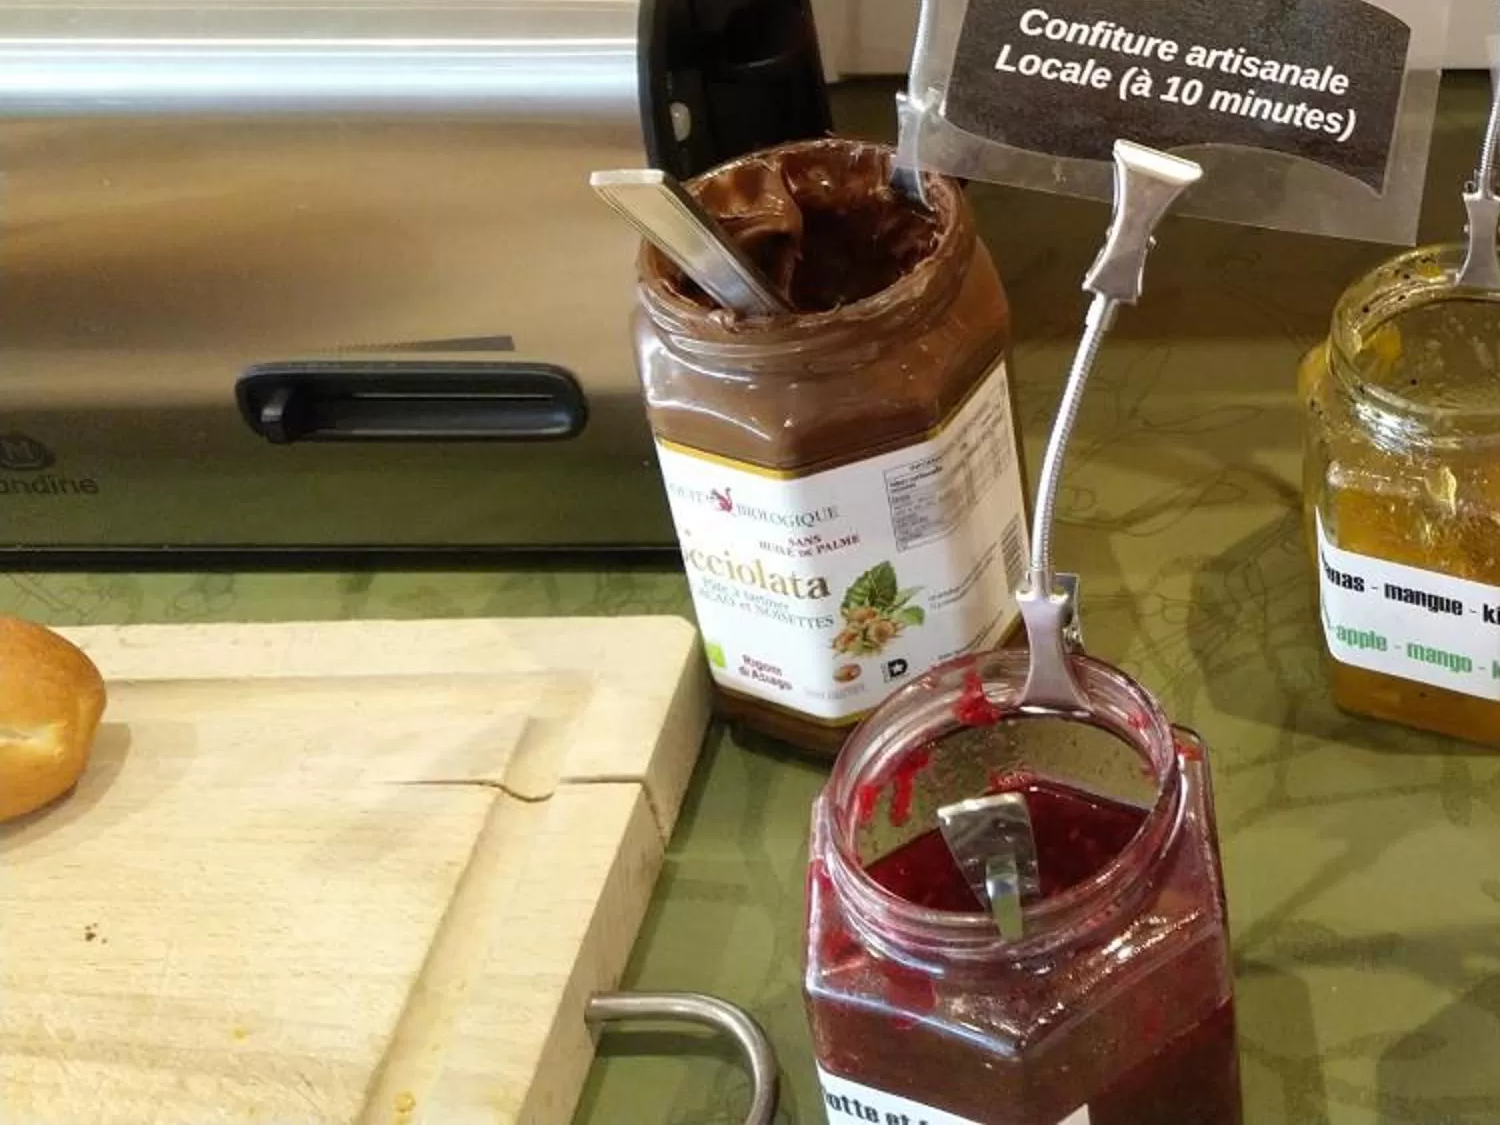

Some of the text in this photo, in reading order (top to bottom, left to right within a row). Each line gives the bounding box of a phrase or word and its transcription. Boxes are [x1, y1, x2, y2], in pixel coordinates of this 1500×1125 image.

[1018, 7, 1351, 97] Confiture artisanale
[994, 42, 1358, 144] Locale (à 10 minutes)
[735, 504, 840, 530] BIOLOGIQUE
[788, 533, 823, 548] SANS
[815, 533, 862, 556] PALME
[1384, 581, 1463, 617] mangue
[1406, 640, 1473, 674] mango
